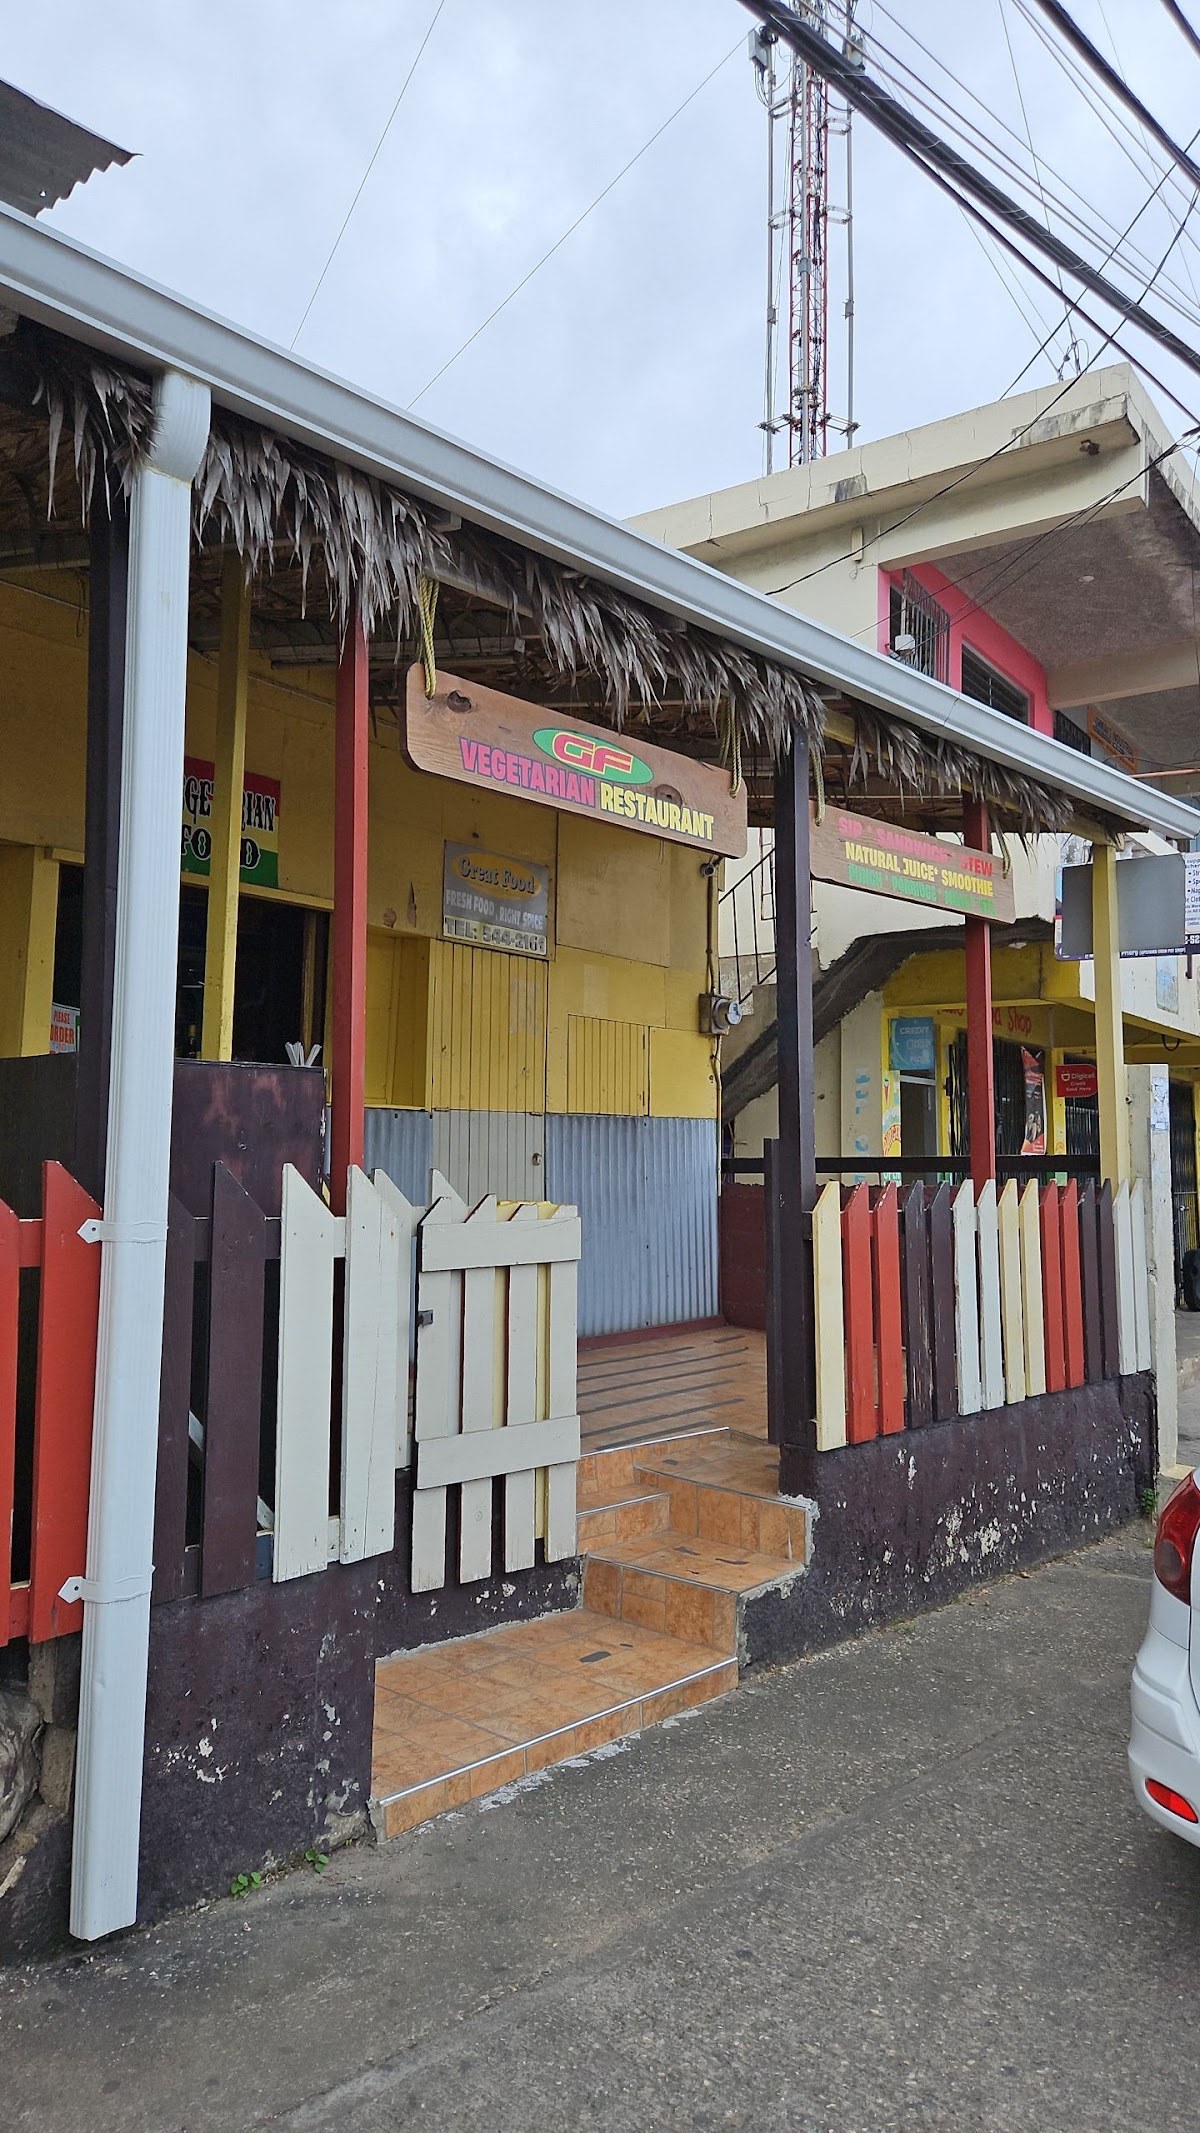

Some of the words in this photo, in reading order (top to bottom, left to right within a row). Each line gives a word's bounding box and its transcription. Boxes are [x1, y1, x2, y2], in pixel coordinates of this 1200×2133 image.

[552, 731, 633, 775] GF
[459, 736, 596, 808] VEGETARIAN
[600, 782, 714, 840] RESTAURANT
[181, 824, 261, 869] FOD
[461, 859, 499, 886] Great
[502, 869, 535, 894] Food
[845, 841, 901, 873] NATURAL
[941, 869, 994, 897] SMOOTHIE
[446, 889, 472, 910] FRESH
[522, 911, 544, 931] SPICE
[900, 1026, 930, 1036] CREDIT
[1007, 1006, 1033, 1036] Shop
[1071, 1073, 1096, 1082] Digicel
